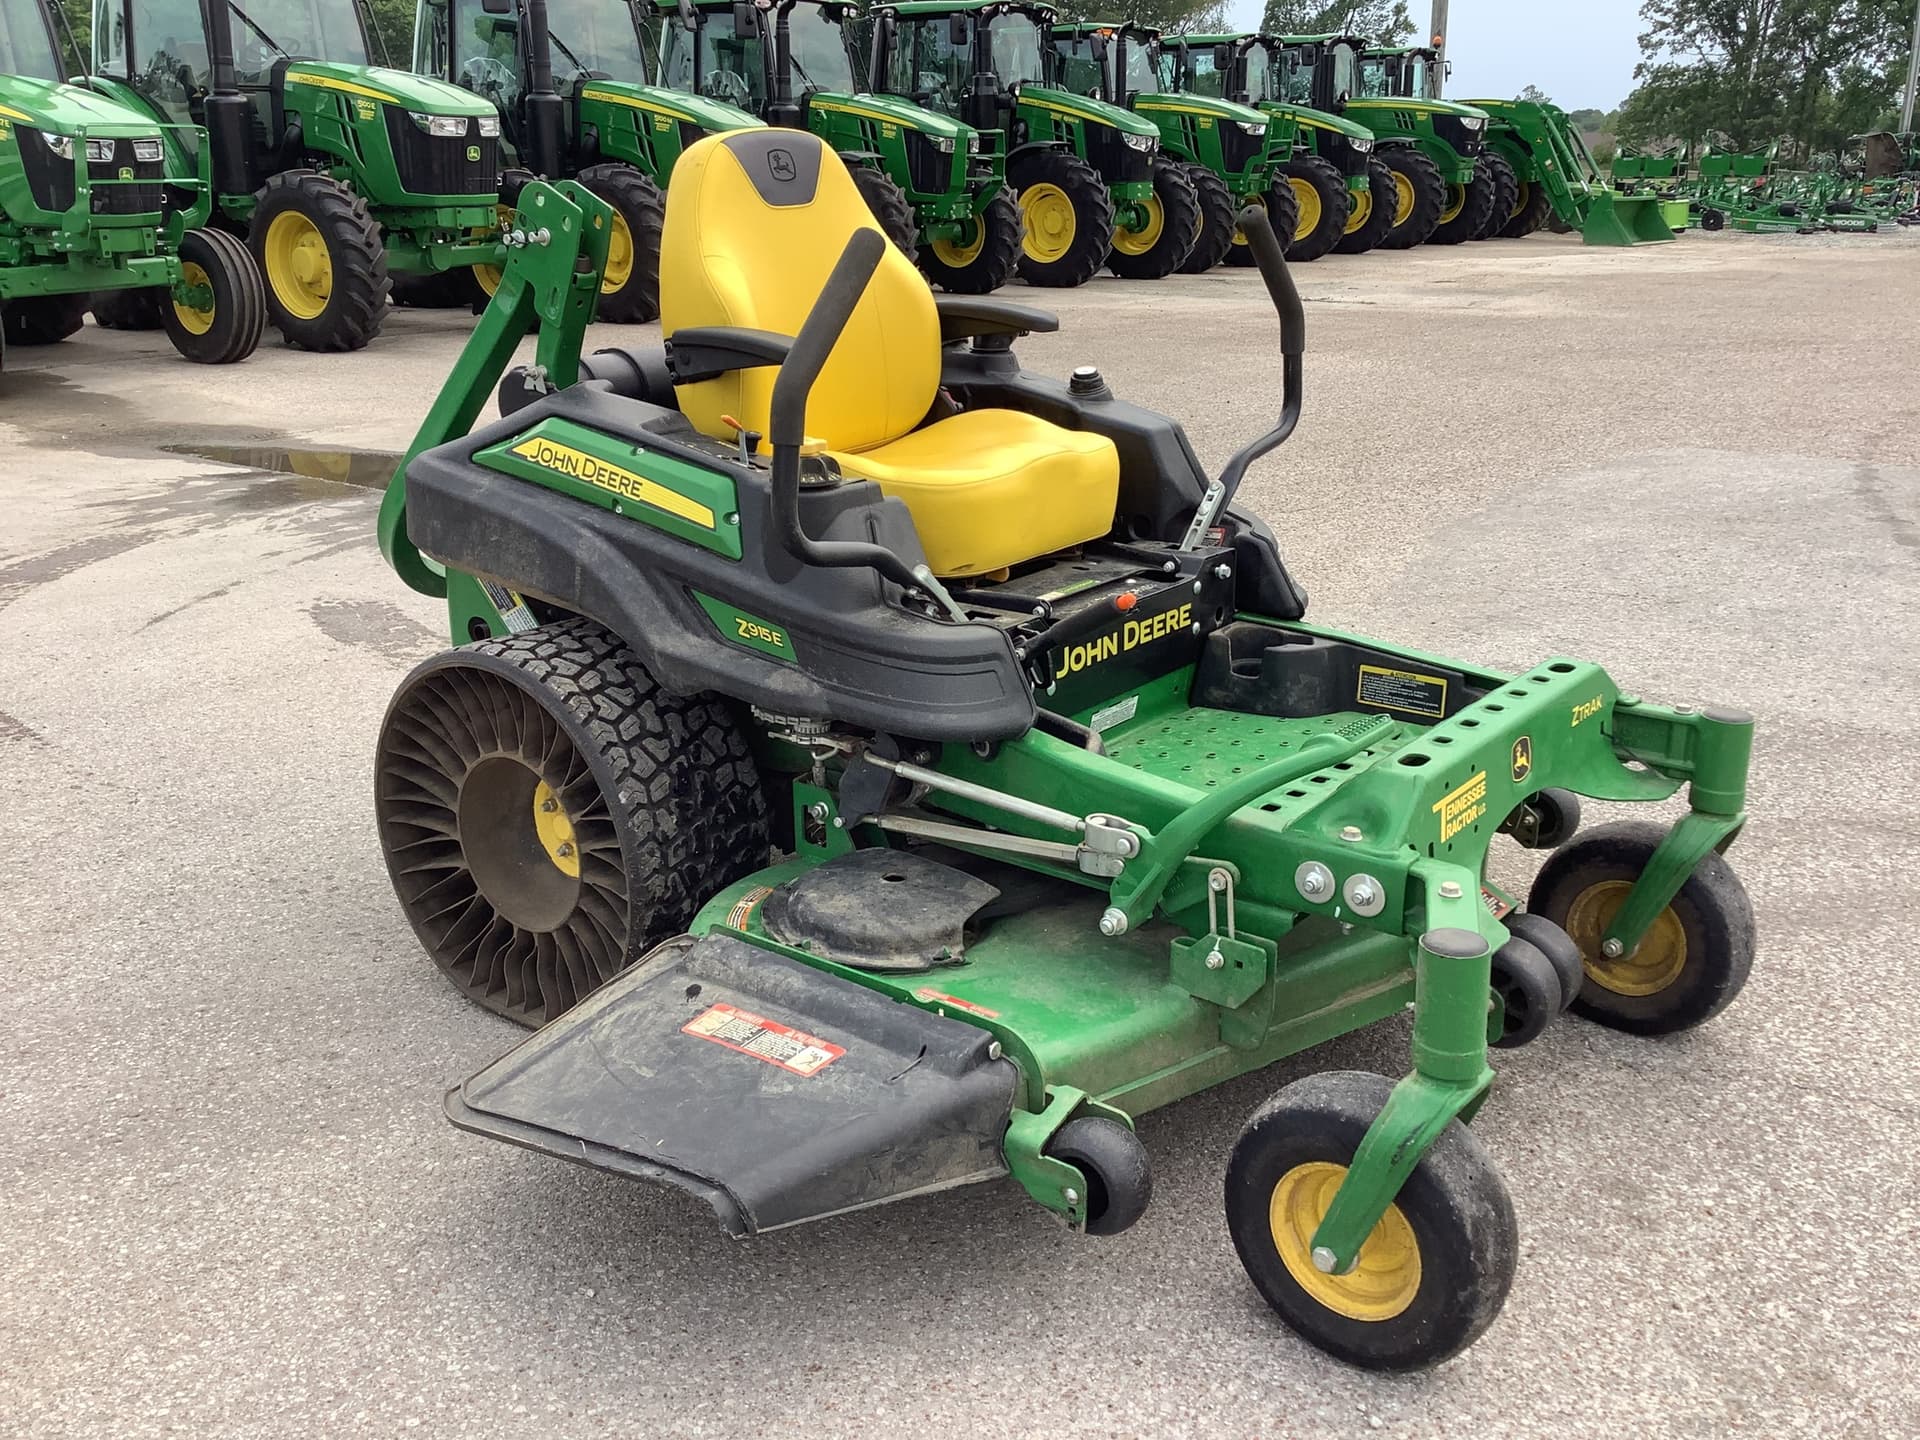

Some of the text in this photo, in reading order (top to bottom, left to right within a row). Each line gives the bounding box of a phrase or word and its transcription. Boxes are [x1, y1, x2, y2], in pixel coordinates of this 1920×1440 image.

[1832, 219, 1865, 227] WOODS
[529, 441, 644, 499] JOHN DEERE
[735, 617, 784, 648] Z915E
[1056, 602, 1193, 680] JOHN DEERE
[1571, 693, 1604, 728] ZTRAK
[1432, 770, 1487, 824] TENNESSEE
